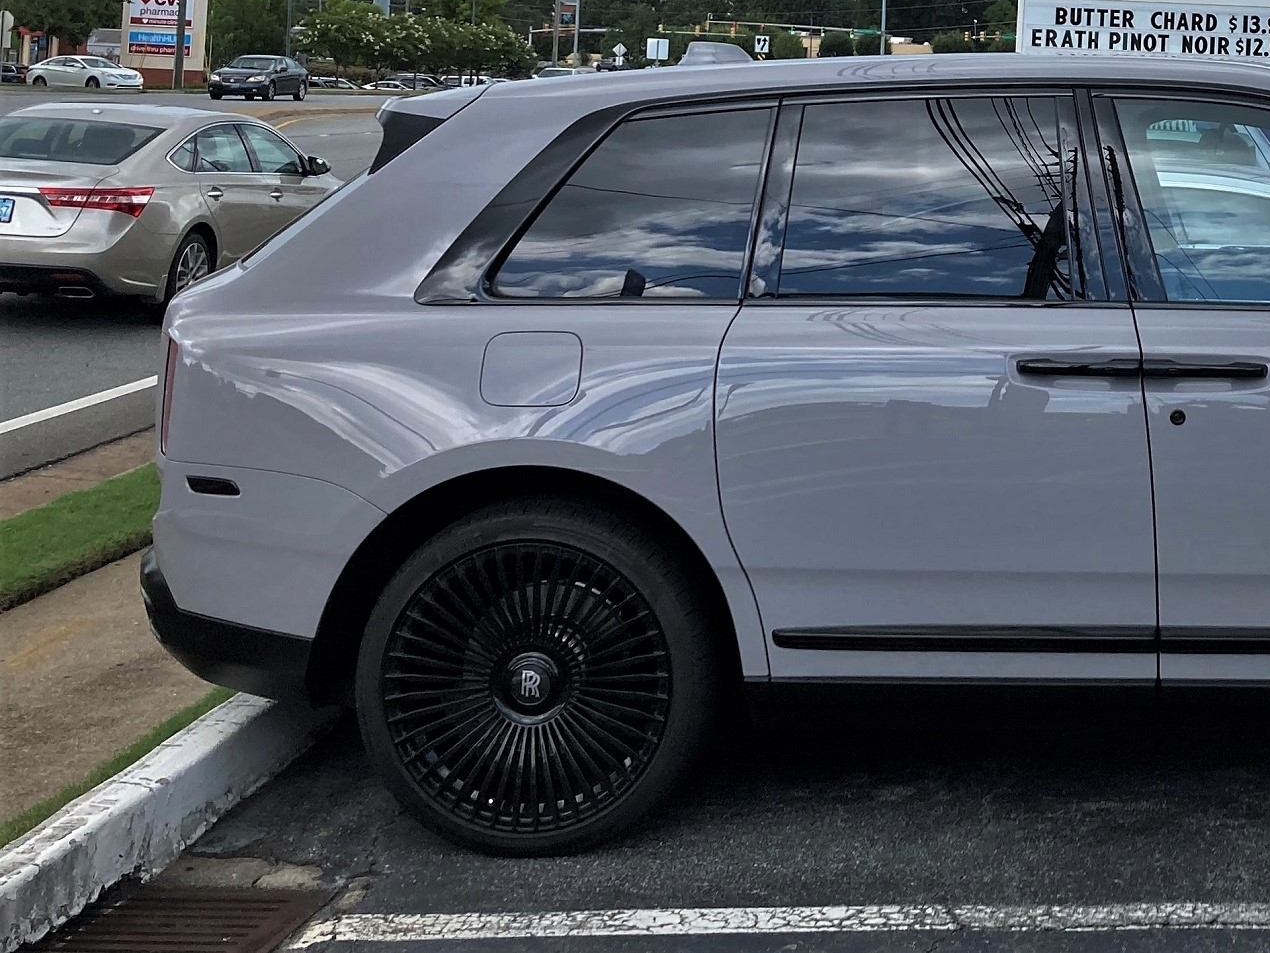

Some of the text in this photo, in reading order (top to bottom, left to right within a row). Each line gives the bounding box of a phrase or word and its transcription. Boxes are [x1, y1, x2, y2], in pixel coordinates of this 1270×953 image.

[139, 7, 179, 17] pharmac
[1055, 7, 1135, 28] BUTTER
[1150, 11, 1218, 32] CHARD
[1031, 28, 1099, 49] ERATH
[1109, 32, 1170, 52] PINOT
[1181, 35, 1230, 55] NOIR
